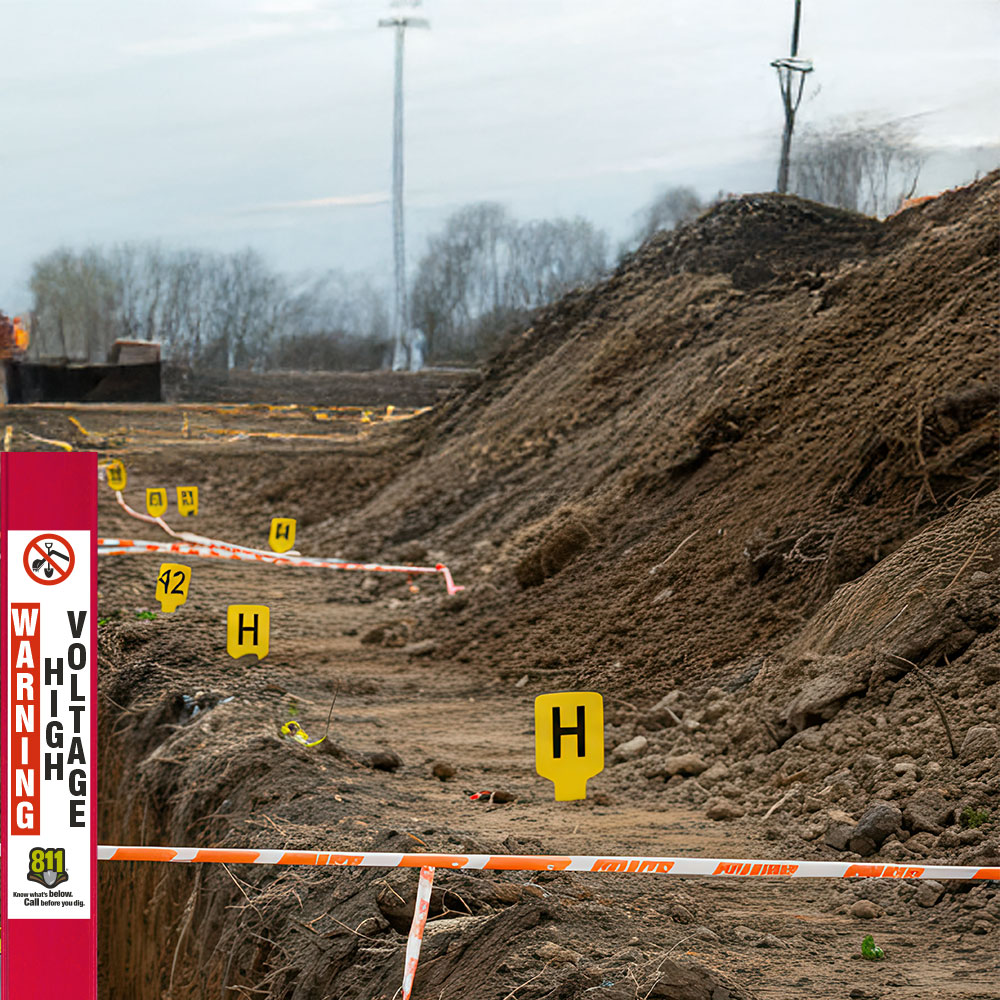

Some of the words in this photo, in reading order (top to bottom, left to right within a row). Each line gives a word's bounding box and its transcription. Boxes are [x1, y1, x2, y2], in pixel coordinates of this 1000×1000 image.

[238, 613, 258, 646] H
[11, 608, 39, 829] WARNING
[45, 658, 63, 780] HIGH
[67, 611, 87, 827] VOLTAGE
[552, 706, 585, 759] H
[30, 848, 64, 873] 811
[24, 898, 39, 906] Call
